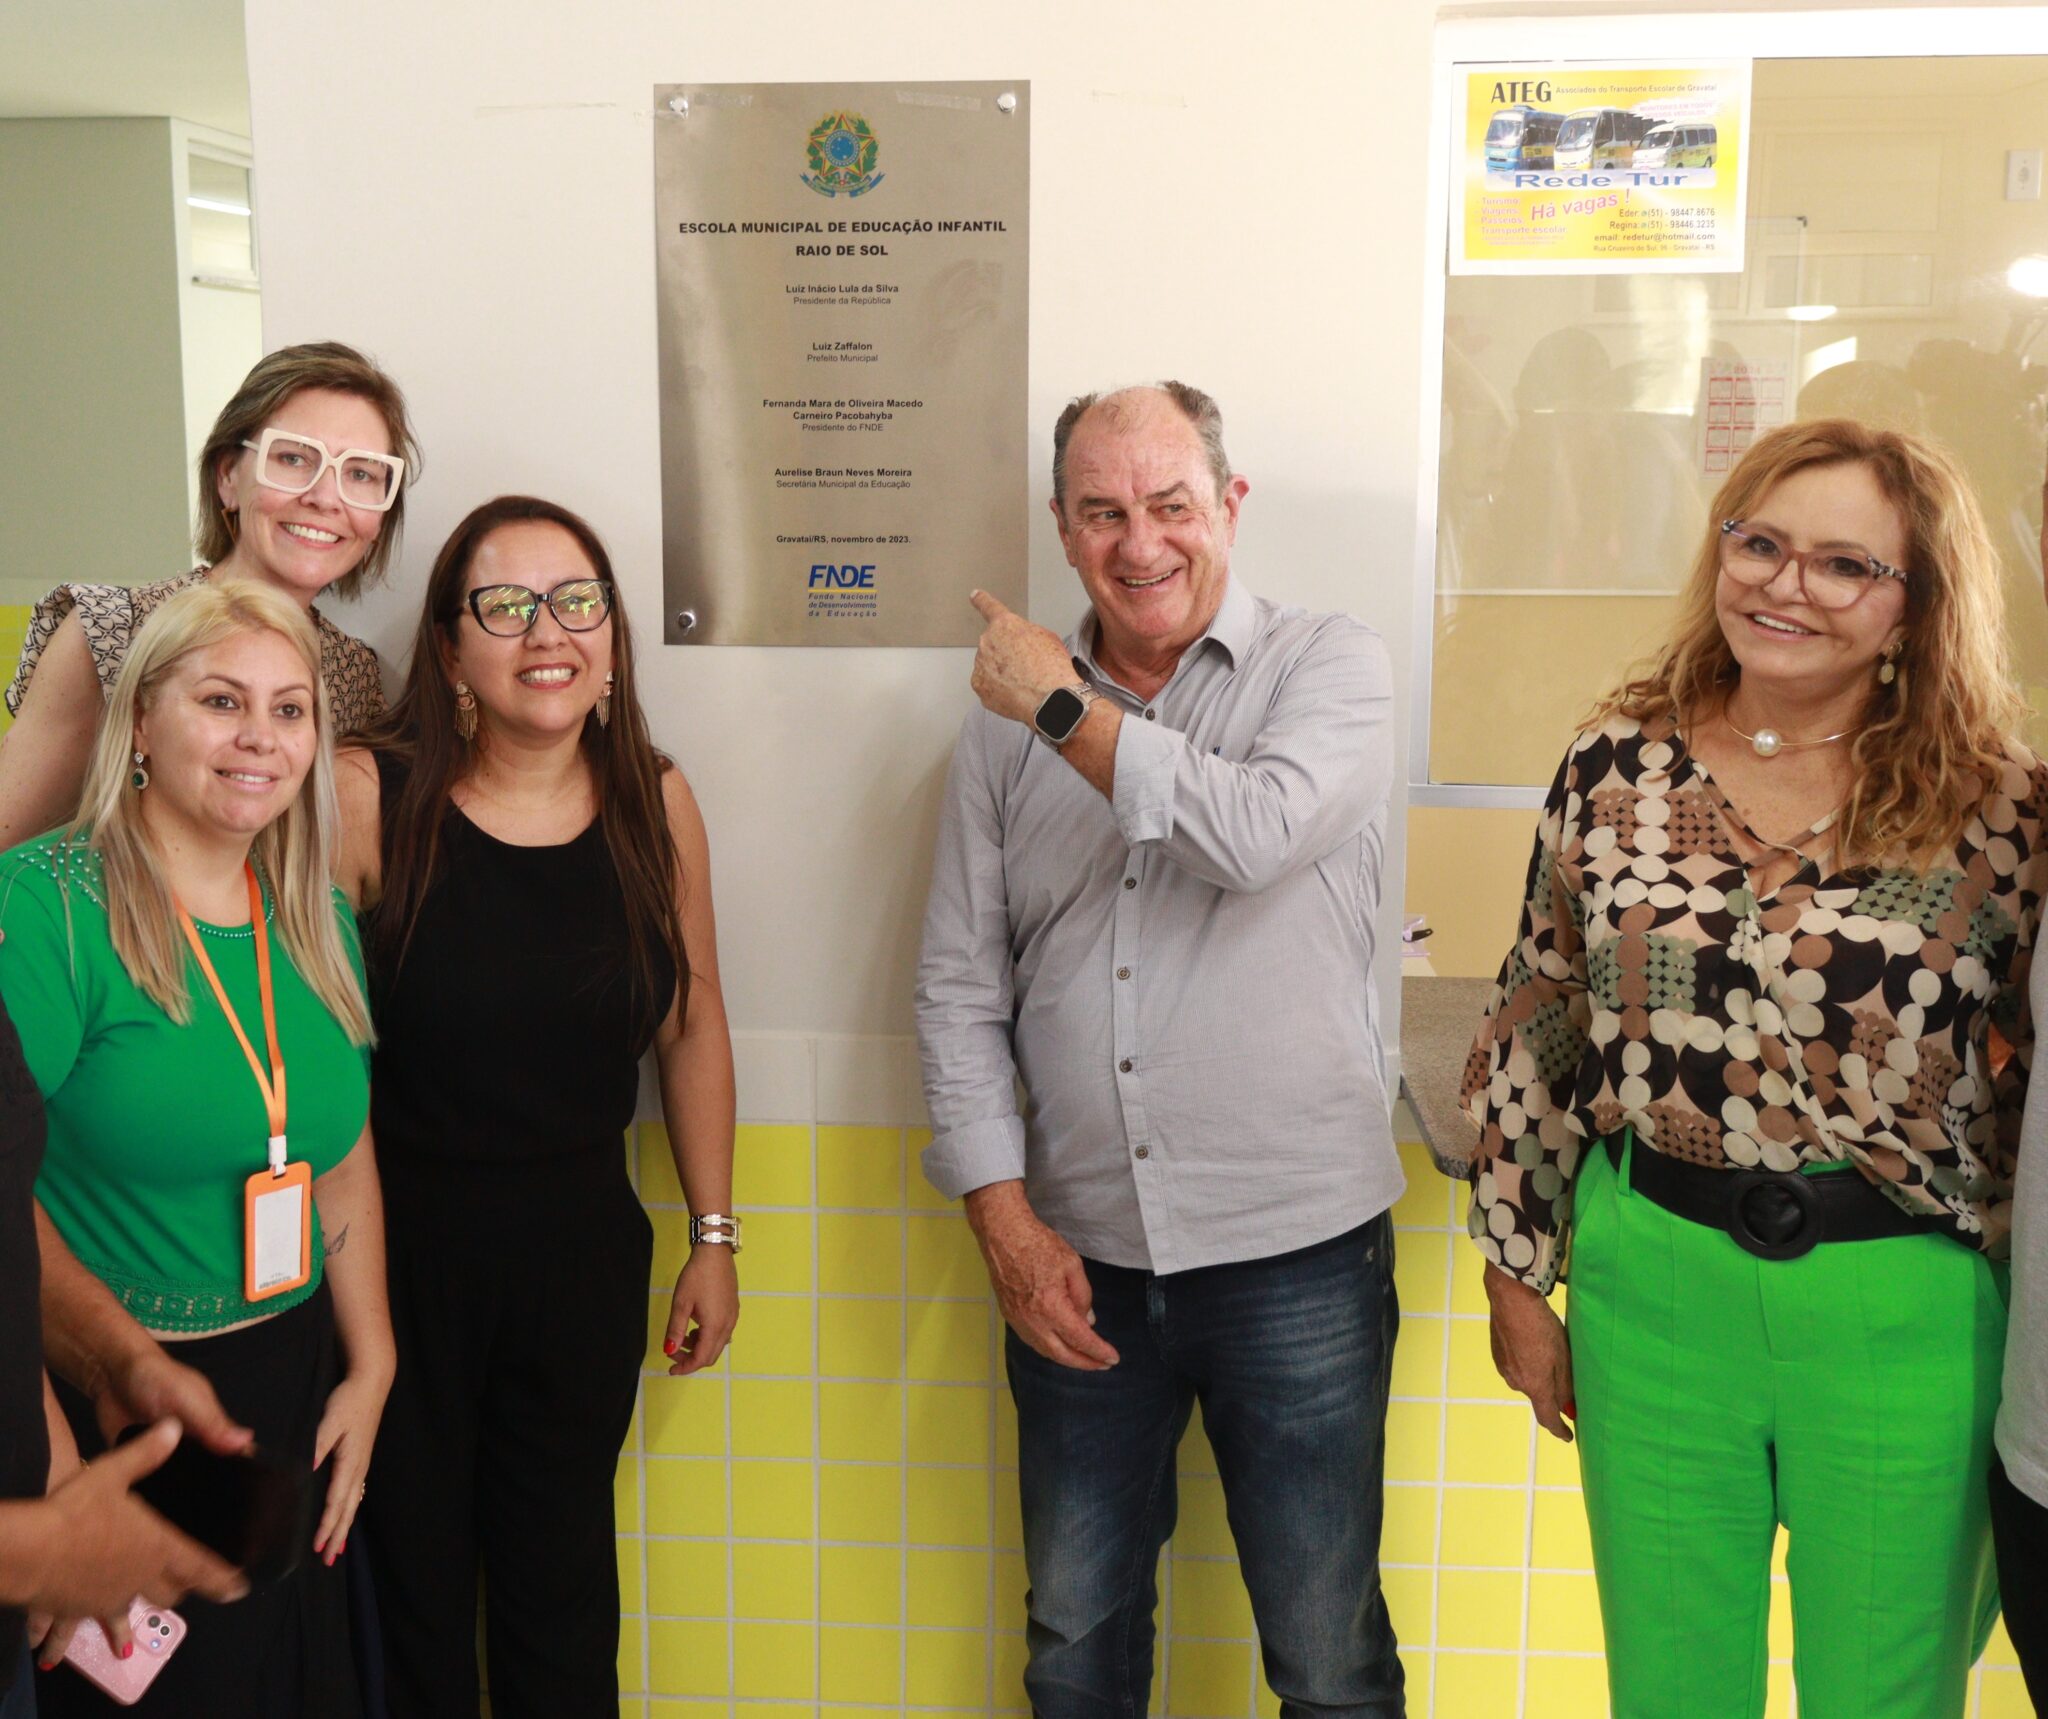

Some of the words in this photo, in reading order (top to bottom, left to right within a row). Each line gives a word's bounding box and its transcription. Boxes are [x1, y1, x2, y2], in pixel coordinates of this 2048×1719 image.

[1490, 80, 1551, 103] ATEG
[1610, 84, 1647, 94] Transporte
[1648, 84, 1676, 92] Escolar
[1515, 173, 1612, 188] Rede
[1626, 172, 1689, 186] Tur
[1531, 202, 1556, 220] Há
[1562, 193, 1619, 215] vagas
[679, 222, 736, 233] ESCOLA
[741, 222, 823, 233] MUNICIPAL
[828, 222, 847, 232] DE
[852, 219, 933, 235] EDUCAÇÃO
[938, 221, 1007, 232] INFANTIL
[1481, 226, 1530, 236] Transporte
[796, 245, 831, 256] RAIO
[836, 245, 855, 256] DE
[860, 245, 888, 256] SOL
[786, 284, 805, 293] Luiz
[808, 284, 836, 293] Inácio
[839, 284, 859, 293] Lula
[861, 284, 873, 293] da
[876, 284, 899, 293] Silva
[793, 296, 836, 305] Presidente
[838, 296, 848, 304] da
[851, 296, 891, 306] República
[812, 342, 832, 351] Luiz
[834, 342, 873, 351] Zaffalon
[807, 354, 838, 362] Prefeito
[840, 354, 878, 364] Municipal
[763, 399, 806, 408] Fernanda
[809, 399, 832, 408] Mara
[834, 399, 846, 408] de
[849, 399, 884, 408] Oliveira
[887, 399, 923, 408] Macedo
[793, 411, 833, 420] Carneiro
[835, 411, 893, 422] Pacobahyba
[802, 423, 845, 432] Presidente
[847, 423, 857, 432] do
[859, 423, 883, 432] FNDE
[775, 468, 812, 477] Aurelise
[815, 468, 843, 477] Braun
[846, 468, 874, 477] Neves
[877, 468, 912, 477] Moreira
[776, 479, 817, 488] Secretária
[819, 479, 856, 490] Municipal
[858, 480, 868, 488] da
[871, 480, 911, 490] Educação
[831, 535, 873, 544] novembro
[876, 535, 886, 544] de
[888, 535, 911, 544] 2023.
[808, 564, 876, 588] FNDE
[827, 610, 877, 618] Educação
